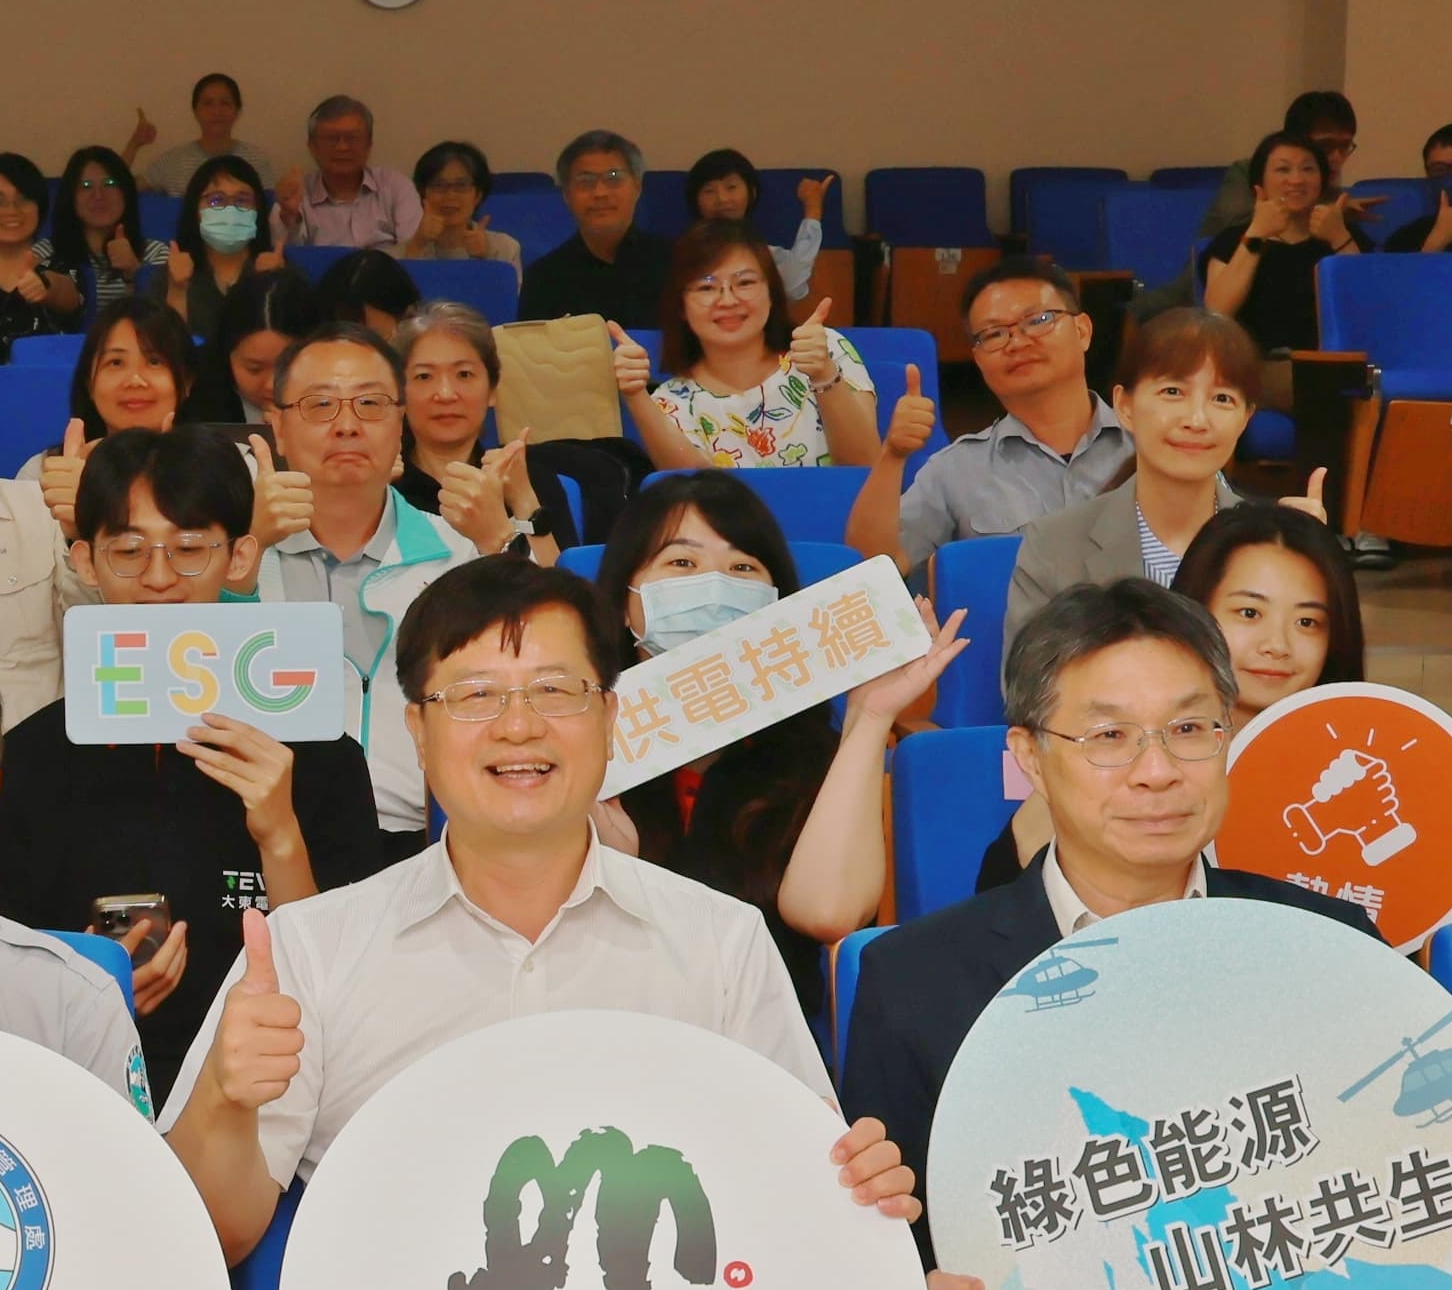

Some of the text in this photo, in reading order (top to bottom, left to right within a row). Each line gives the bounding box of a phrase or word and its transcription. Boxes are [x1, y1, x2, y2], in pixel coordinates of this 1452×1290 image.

[93, 628, 318, 718] ESG
[607, 589, 893, 764] 供電持續
[221, 893, 269, 911] 大東電
[990, 1077, 1313, 1247] 綠色能源
